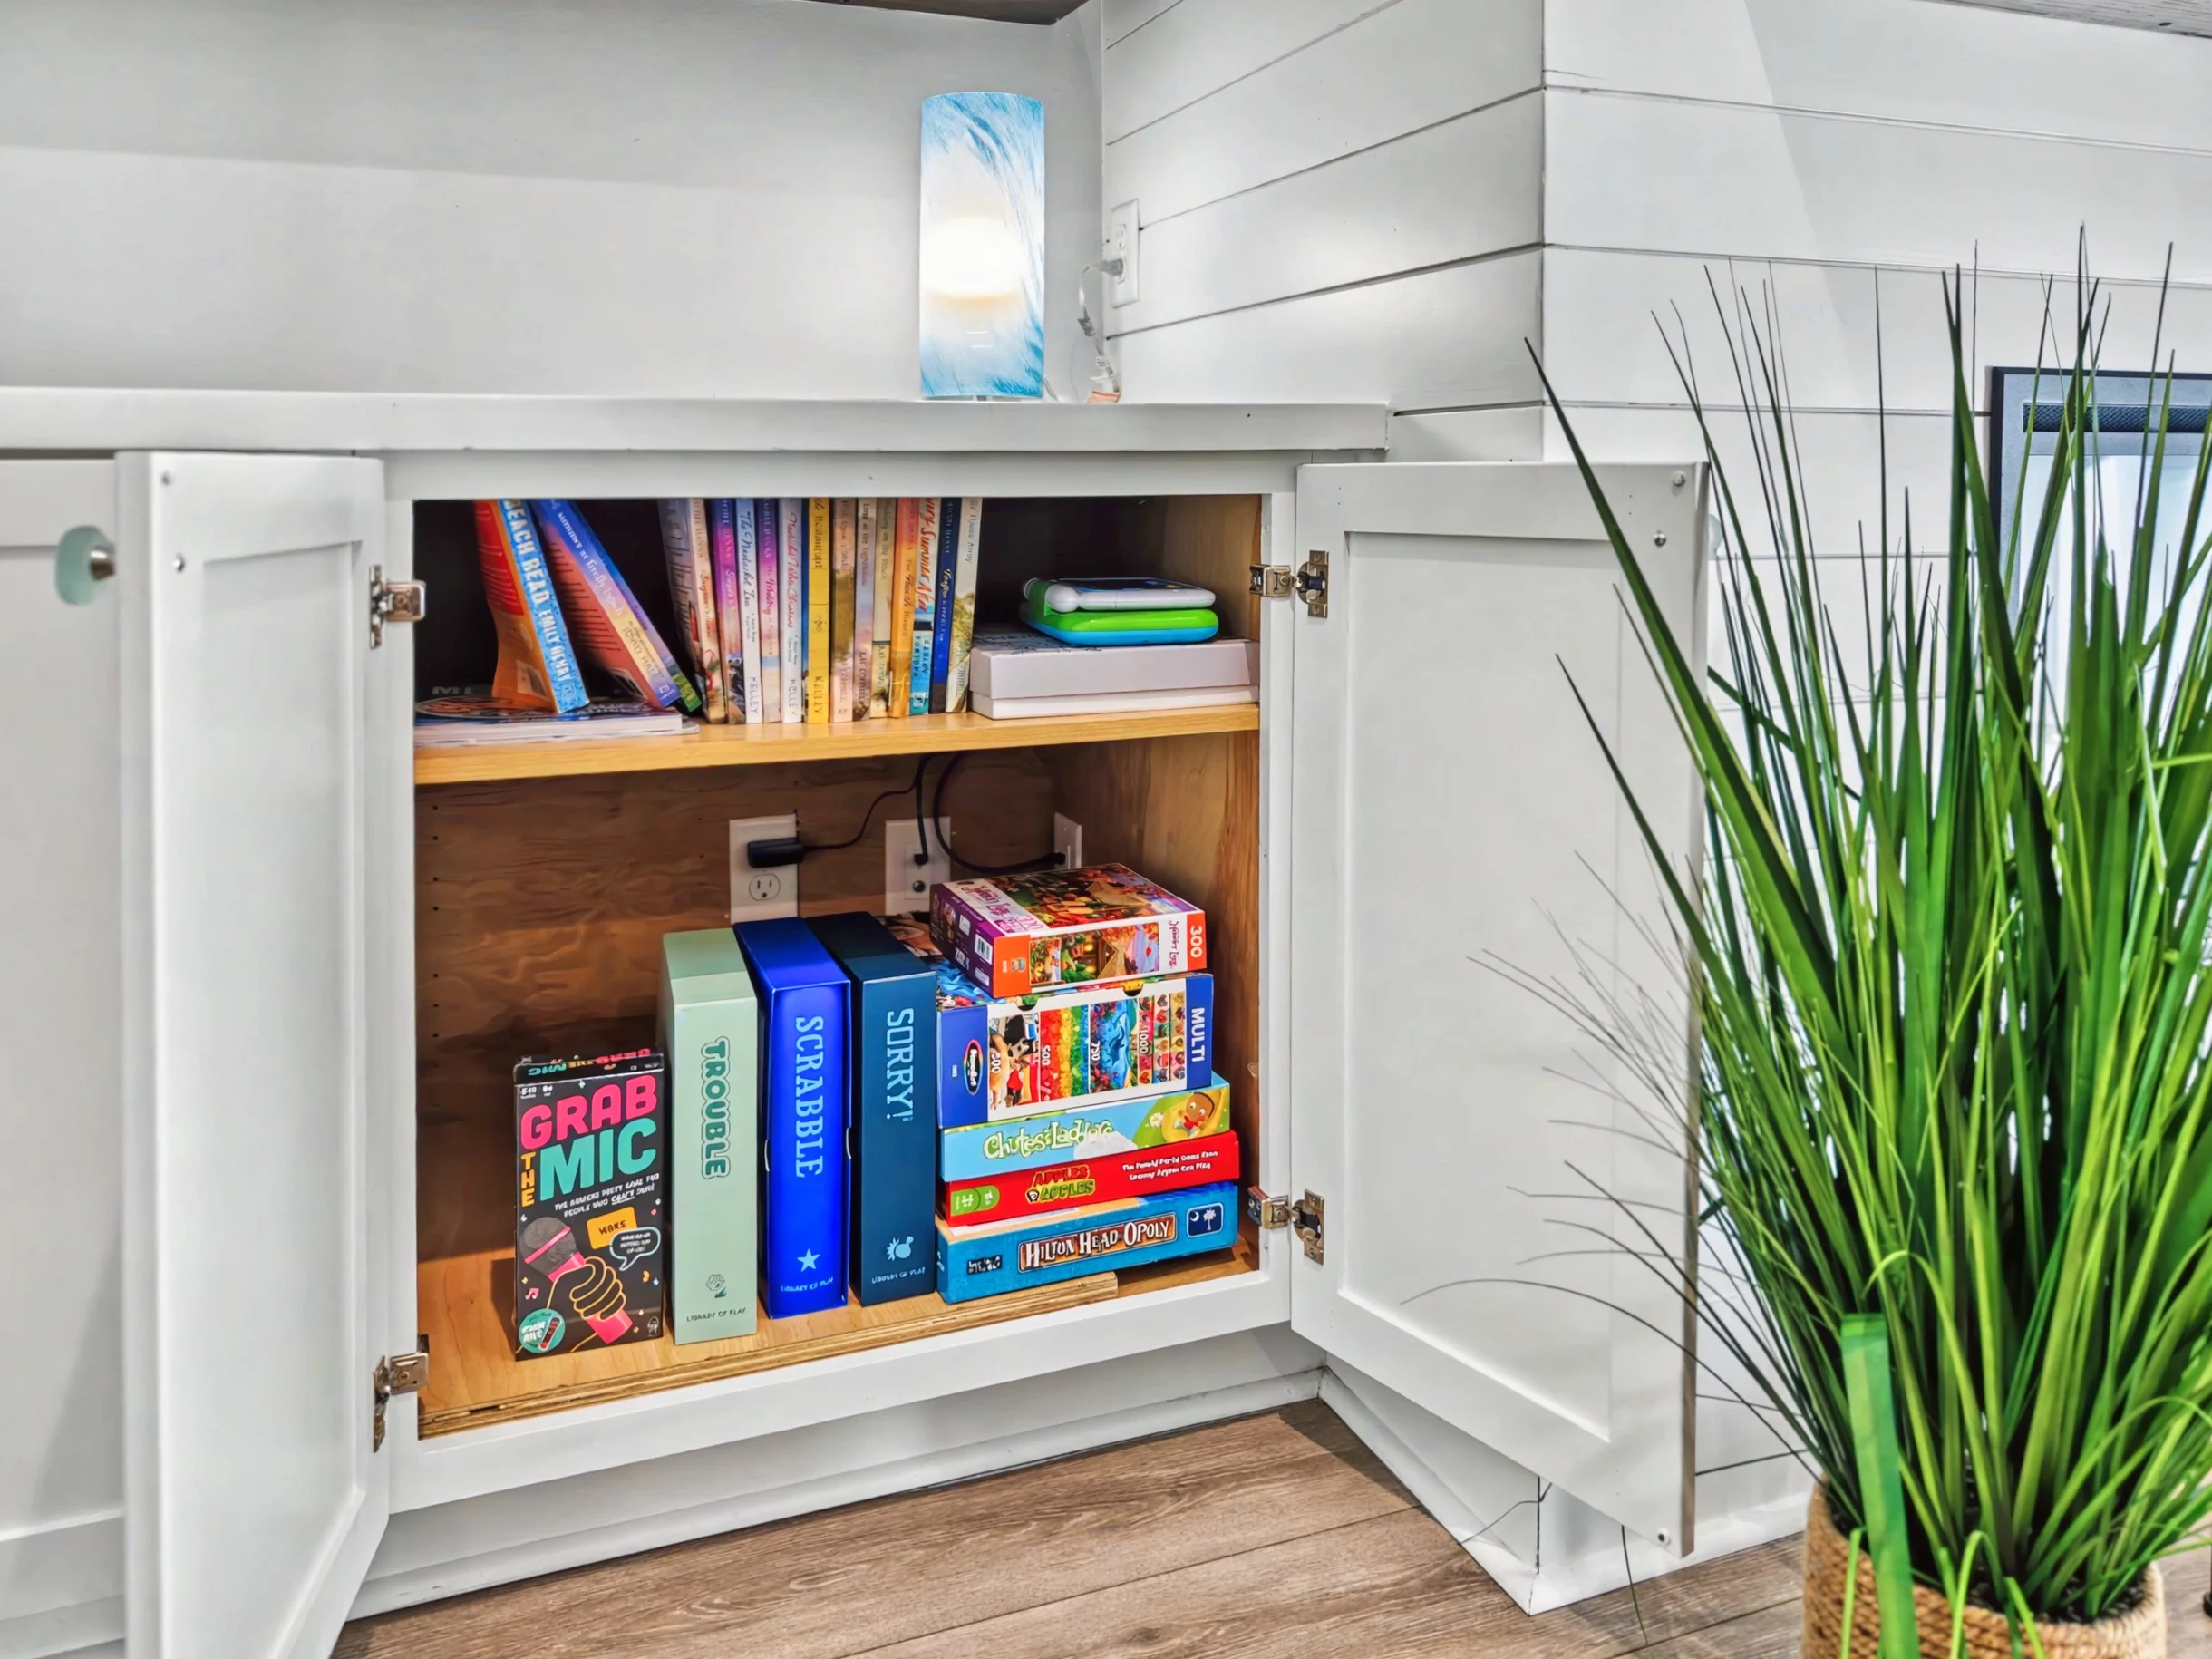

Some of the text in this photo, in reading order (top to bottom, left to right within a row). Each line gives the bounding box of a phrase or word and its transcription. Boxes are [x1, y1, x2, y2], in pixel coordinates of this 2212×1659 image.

[918, 528, 936, 581] Summer
[520, 557, 551, 605] READ
[538, 609, 572, 681] EMILY HENRY
[748, 676, 759, 714] KELLEY
[789, 679, 799, 717] KELLEY
[814, 675, 824, 714] KELLEY
[1189, 925, 1203, 958] 300
[1041, 1045, 1051, 1065] 500
[1139, 1029, 1150, 1055] 1000
[1191, 1007, 1206, 1062] MULTI
[887, 1007, 914, 1121] SORRY!
[520, 1074, 658, 1150] GRAB
[703, 1038, 729, 1178] TROUBLE
[795, 1015, 824, 1178] SCRABBLE
[539, 1117, 657, 1202] MIC
[983, 1126, 1046, 1159] Chutes
[520, 1151, 537, 1208] THE
[1025, 1241, 1075, 1268] HILTON
